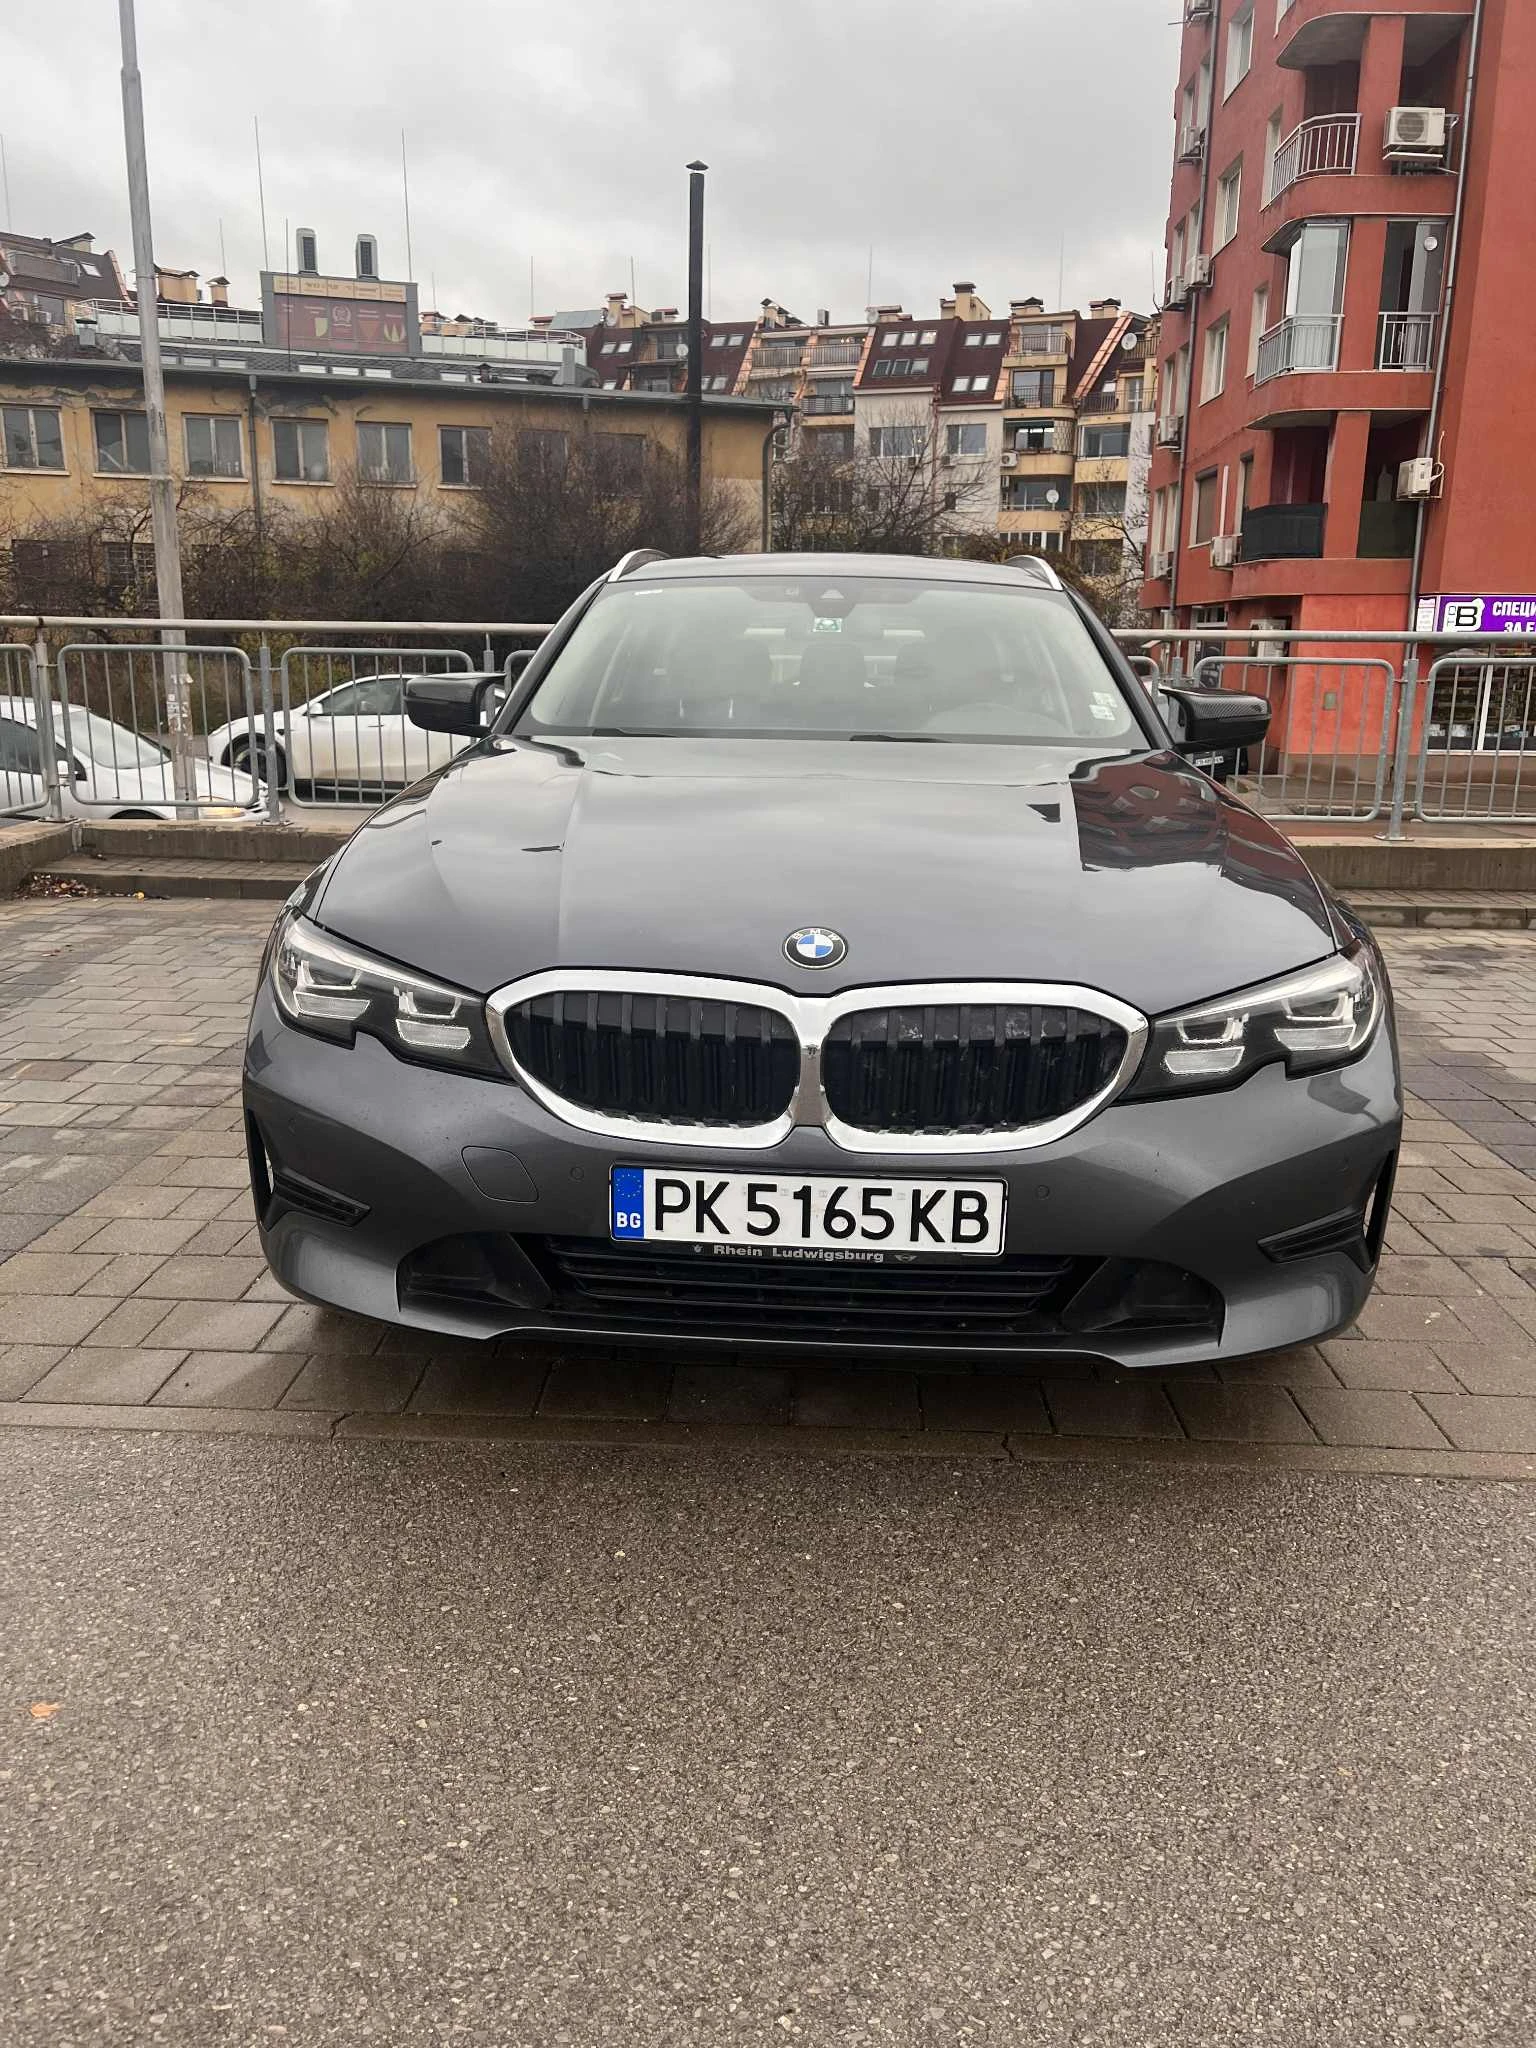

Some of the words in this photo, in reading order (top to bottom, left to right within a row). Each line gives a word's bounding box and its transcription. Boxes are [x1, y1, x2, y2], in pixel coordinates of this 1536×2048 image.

[616, 1211, 642, 1229] BG
[655, 1178, 730, 1235] PK
[746, 1183, 895, 1241] 5165
[909, 1188, 990, 1244] KB
[713, 1244, 763, 1257] Rhein
[772, 1246, 884, 1263] Ludwigsburg
